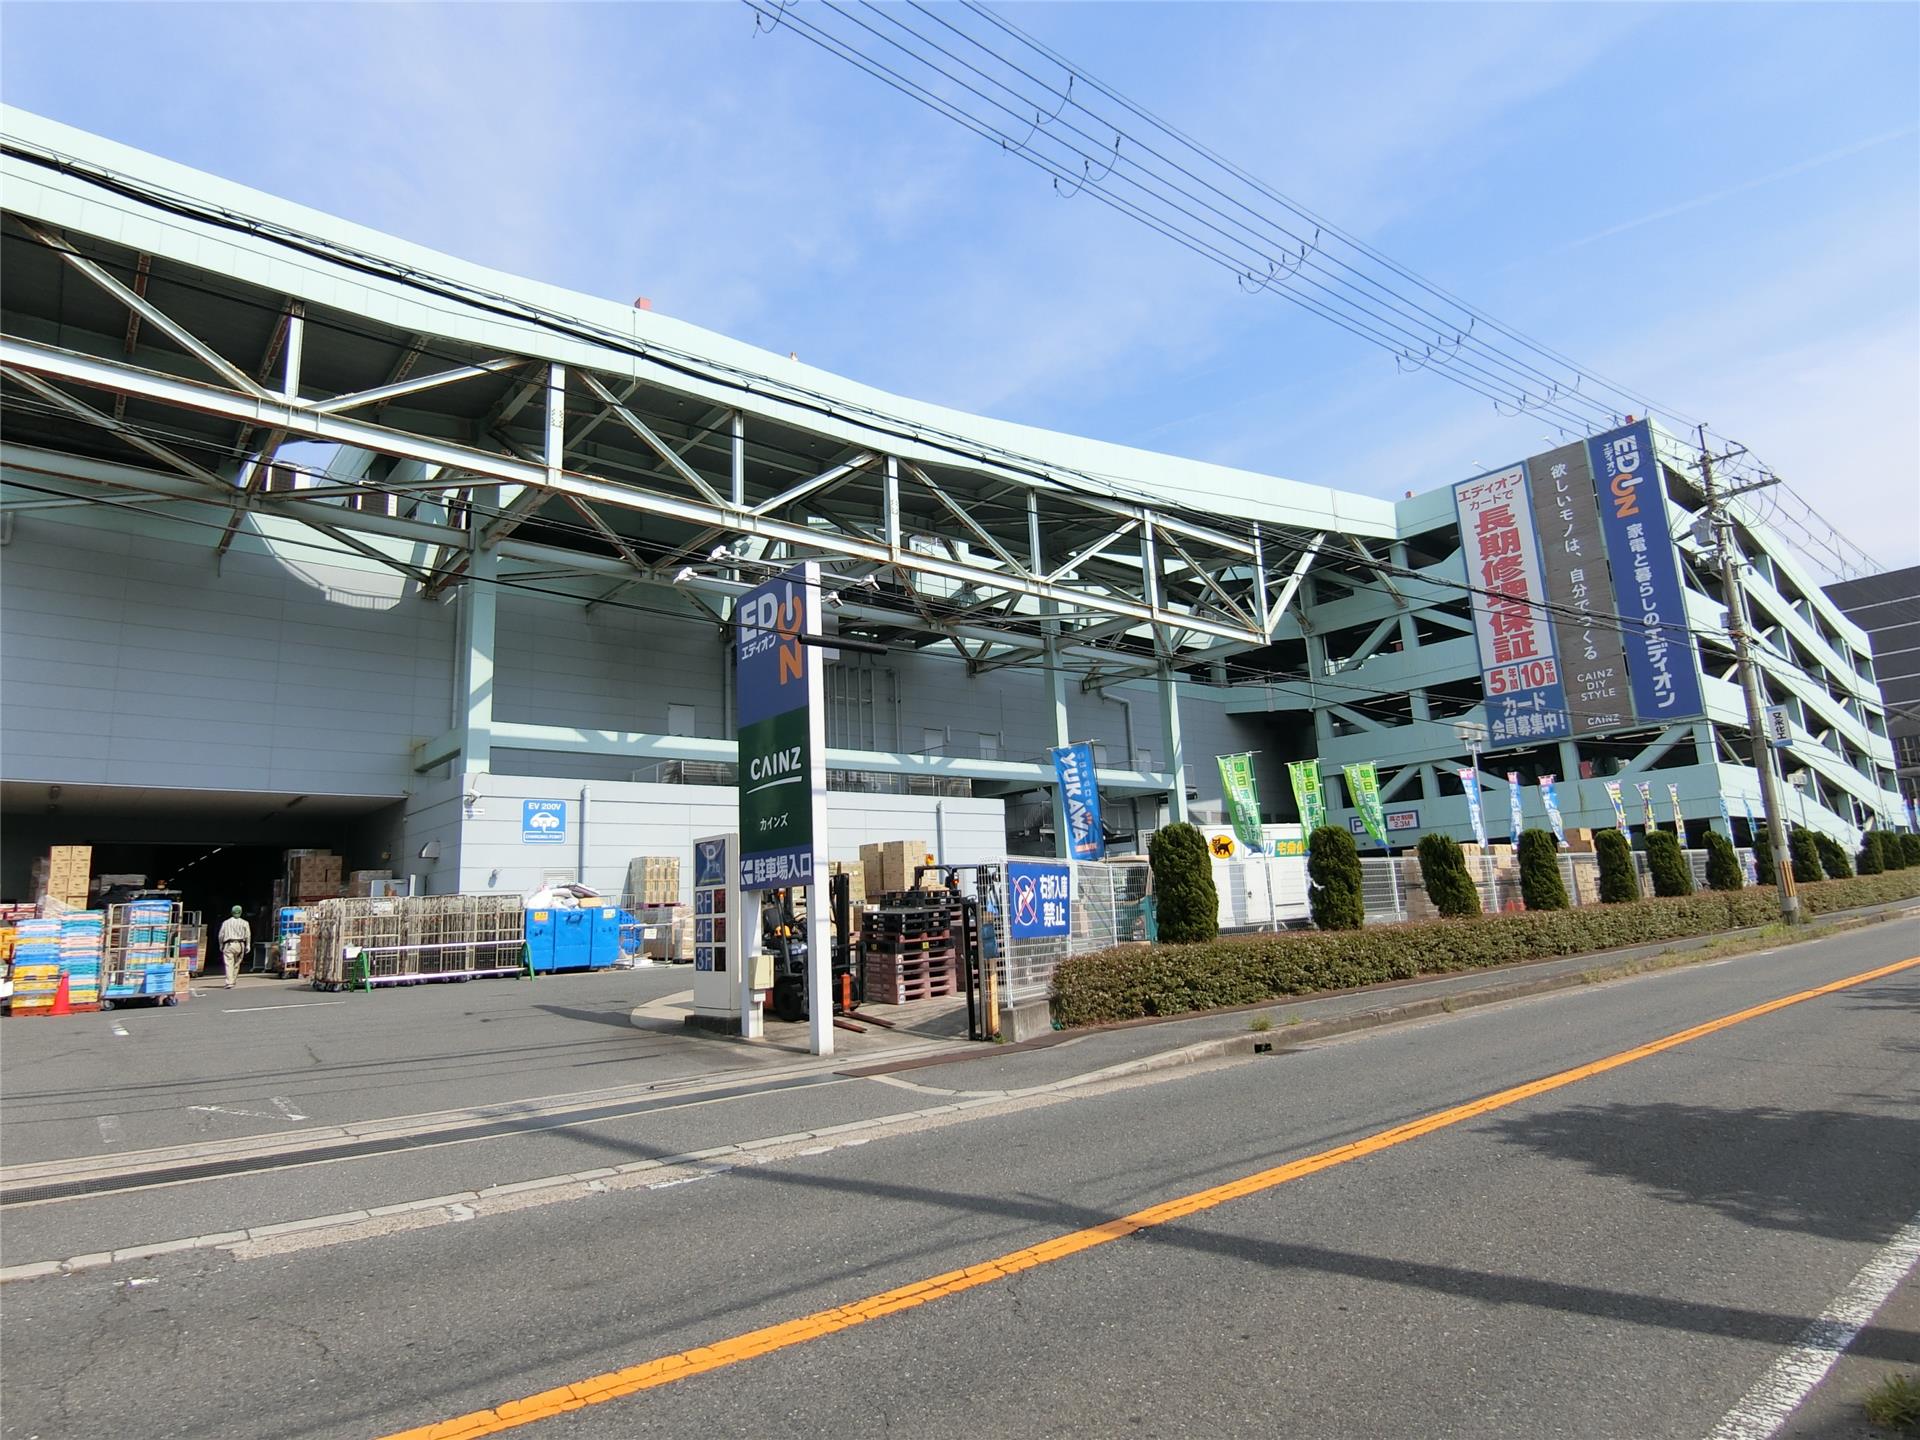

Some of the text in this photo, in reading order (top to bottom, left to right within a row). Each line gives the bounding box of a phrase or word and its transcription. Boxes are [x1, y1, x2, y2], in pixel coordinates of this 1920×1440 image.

[1458, 473, 1523, 502] エディオン
[1611, 435, 1643, 518] EDION
[1469, 490, 1514, 511] カードで
[1474, 503, 1538, 663] 長期修理保証
[742, 635, 776, 660] エディオン
[1577, 668, 1614, 682] CAINZ
[1586, 680, 1606, 691] DIY
[1502, 692, 1546, 714] カード
[1581, 688, 1616, 702] STYLE
[1587, 713, 1621, 726] CAINZ
[750, 746, 802, 781] CAINZ
[528, 802, 540, 810] EV
[1060, 752, 1089, 842] YUKAWA
[760, 812, 789, 831] カインズ
[755, 853, 812, 883] 駐車場入口
[1039, 874, 1068, 900] 右折入庫
[696, 892, 711, 913] RF
[1043, 903, 1066, 927] 禁止
[696, 920, 711, 941] 4F
[697, 948, 711, 970] 3F
